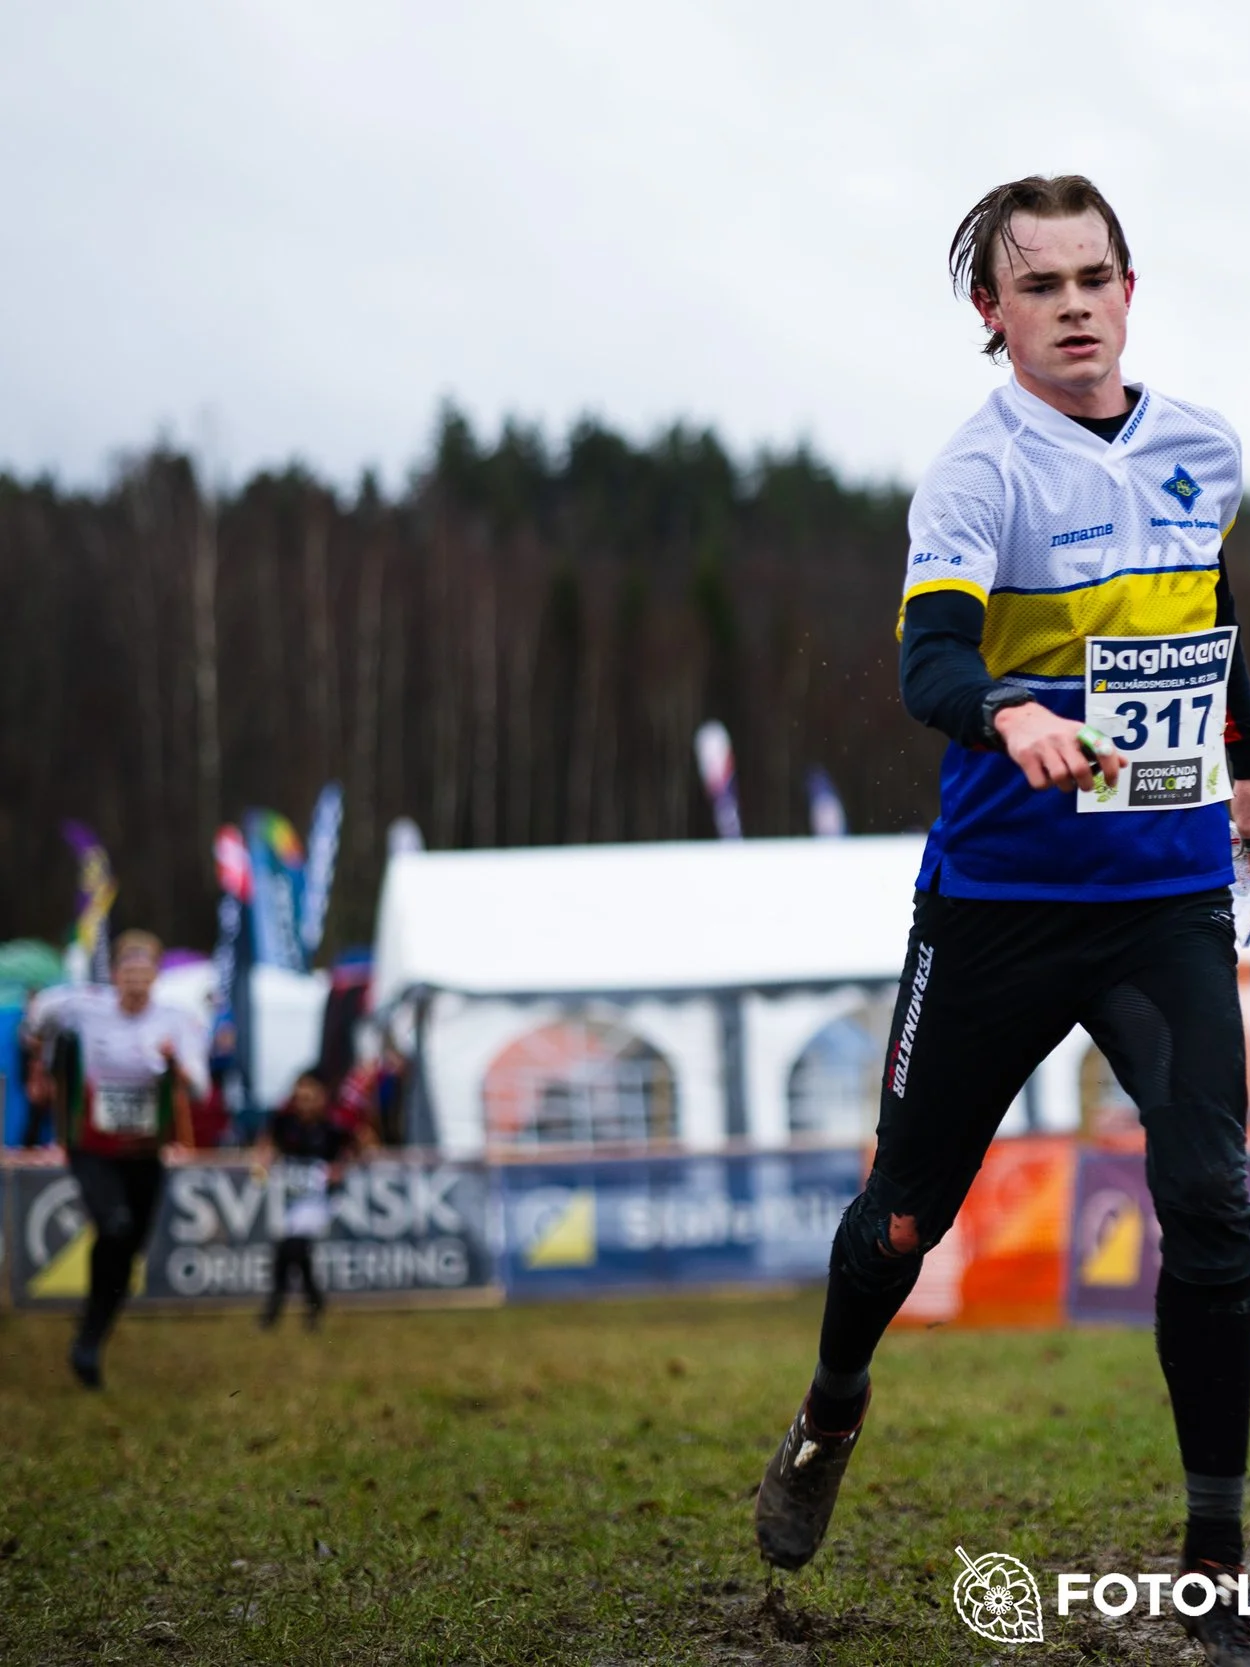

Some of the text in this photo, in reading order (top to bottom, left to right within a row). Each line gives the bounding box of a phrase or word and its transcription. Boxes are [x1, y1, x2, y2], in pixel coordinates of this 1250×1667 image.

[1050, 523, 1113, 547] noname
[1092, 639, 1230, 675] bagheera
[1112, 694, 1213, 751] 317
[1137, 765, 1198, 778] GODKÄNDA
[893, 941, 934, 1098] TERMINATOR
[167, 1238, 468, 1295] ORIETERING
